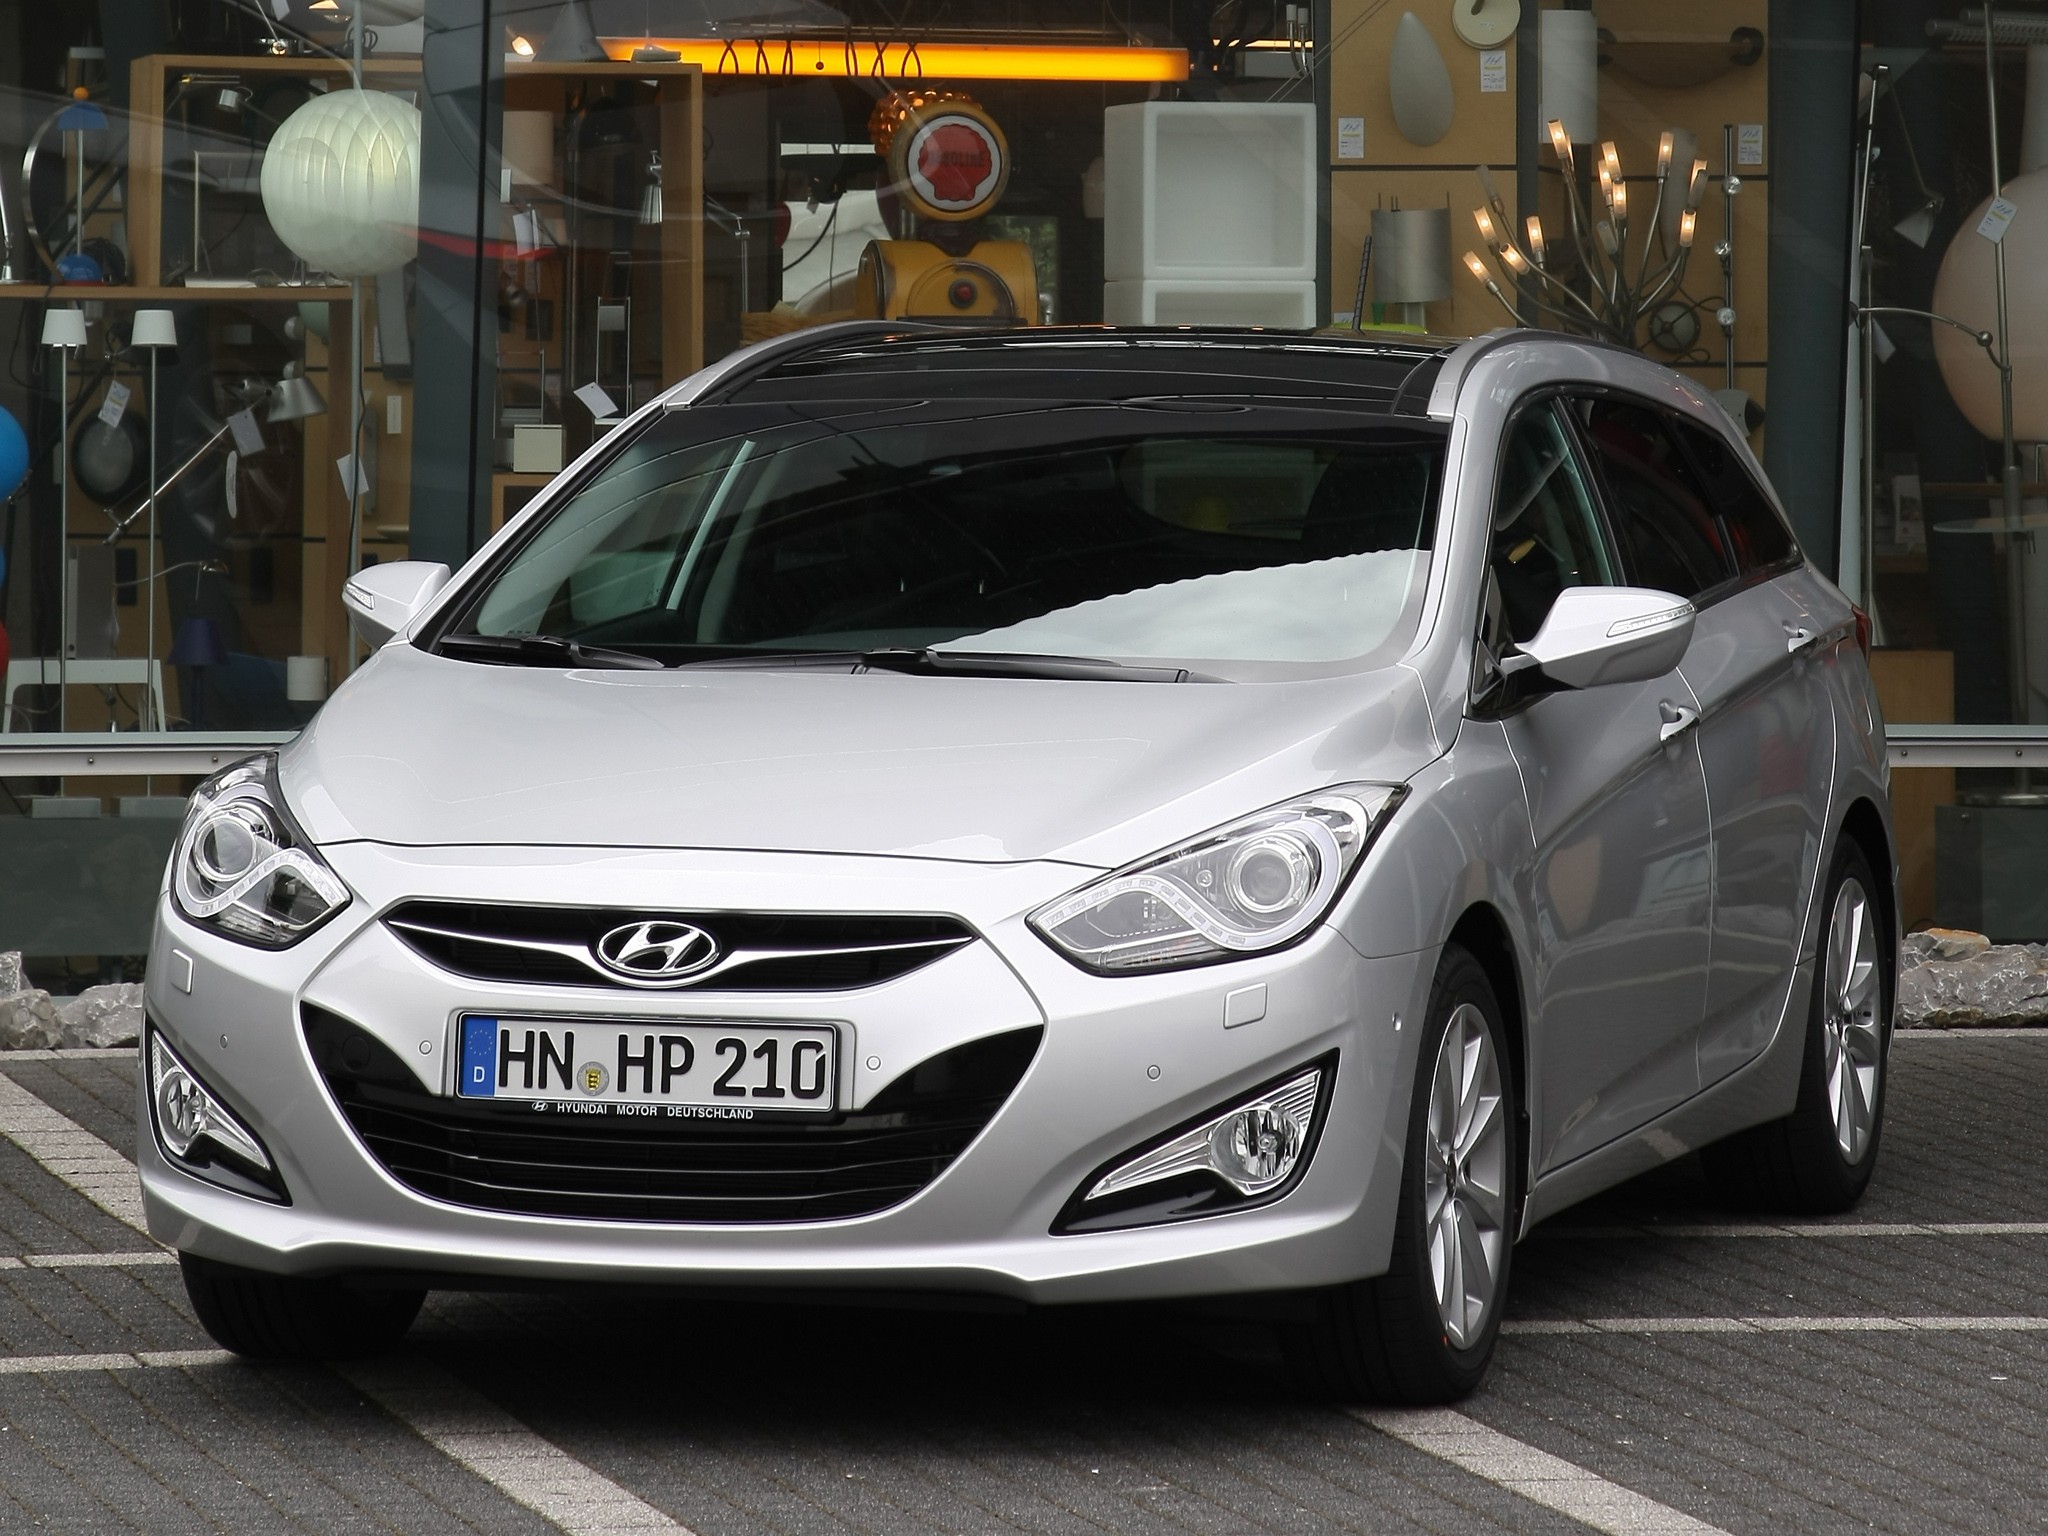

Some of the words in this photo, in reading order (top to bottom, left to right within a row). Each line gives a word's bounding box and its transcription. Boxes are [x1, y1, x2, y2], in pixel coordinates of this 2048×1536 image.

[498, 1029, 574, 1090] HN
[617, 1034, 695, 1094] HP
[713, 1038, 825, 1099] 210
[473, 1066, 485, 1083] D
[557, 1102, 608, 1115] HYUNDAI
[616, 1105, 658, 1117] MOTOR
[667, 1107, 754, 1120] DEUTSCHLAND
